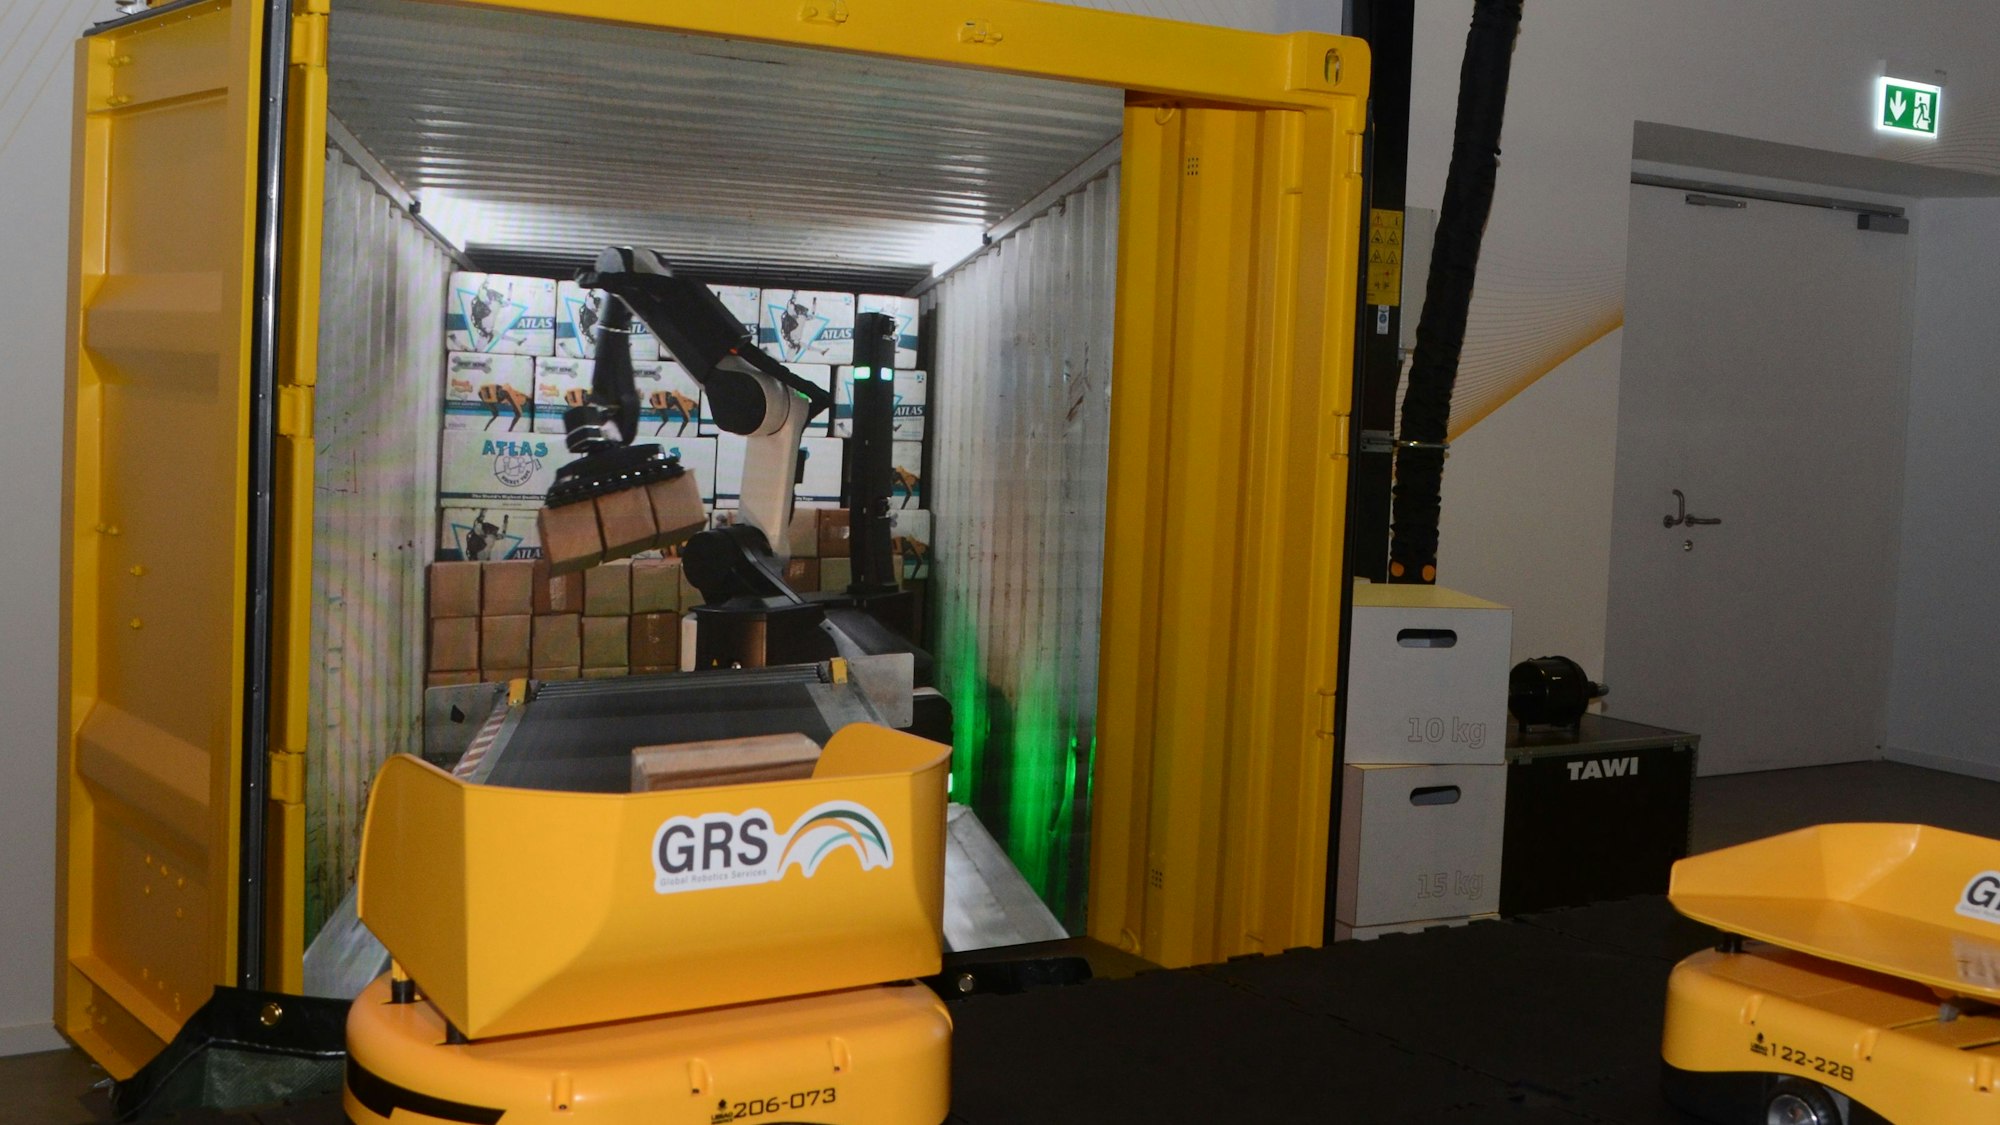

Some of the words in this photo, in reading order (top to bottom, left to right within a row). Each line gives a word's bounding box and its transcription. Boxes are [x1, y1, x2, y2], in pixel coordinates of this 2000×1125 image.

[517, 318, 553, 329] ATLAS
[821, 328, 852, 340] ATLAS
[894, 406, 923, 416] ATLAS
[482, 440, 549, 457] ATLAS
[513, 548, 543, 559] ATLA
[1407, 717, 1445, 743] 10
[1451, 716, 1486, 749] kg
[1567, 757, 1639, 781] TAWI
[659, 818, 767, 873] GRS
[661, 876, 689, 887] Global
[691, 872, 729, 883] Robotics
[731, 869, 767, 879] Services
[1417, 873, 1448, 899] 15
[1454, 870, 1484, 900] kg
[1967, 876, 2000, 910] G
[1771, 1043, 1854, 1081] 122-228
[733, 1088, 836, 1119] 206-073
